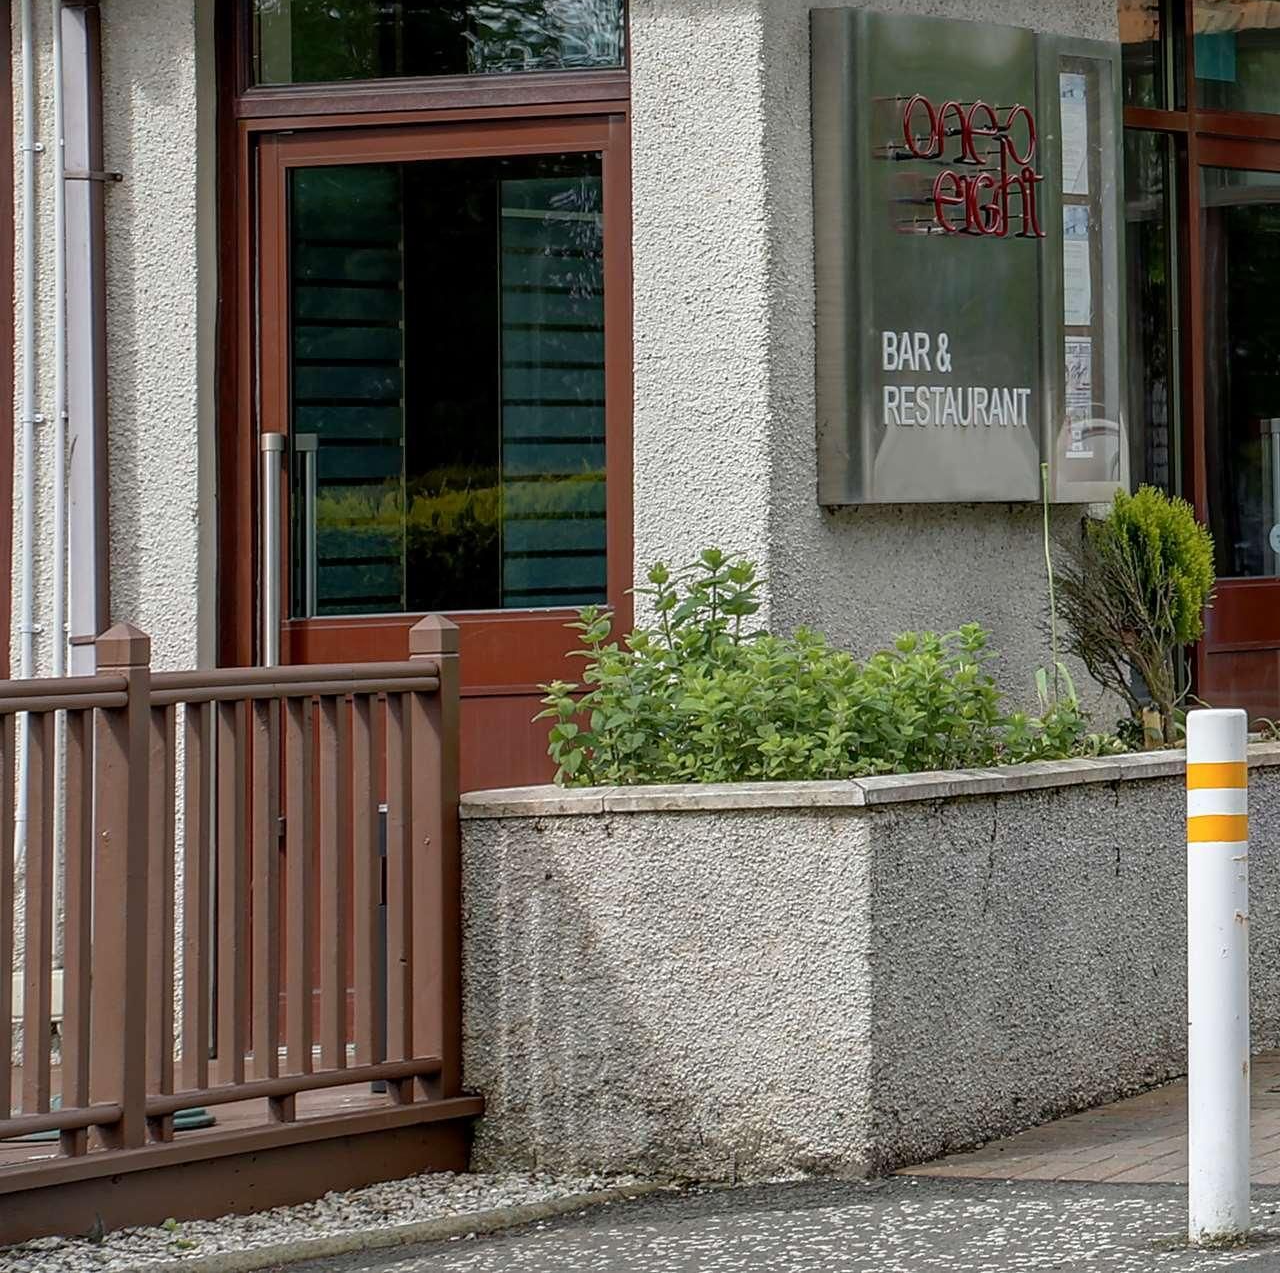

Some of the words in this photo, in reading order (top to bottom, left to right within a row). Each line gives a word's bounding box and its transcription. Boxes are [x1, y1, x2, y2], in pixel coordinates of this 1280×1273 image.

[932, 140, 1046, 238] eight
[882, 330, 931, 372] BAR
[936, 332, 953, 373] &
[883, 385, 1032, 426] RESTAURANT
